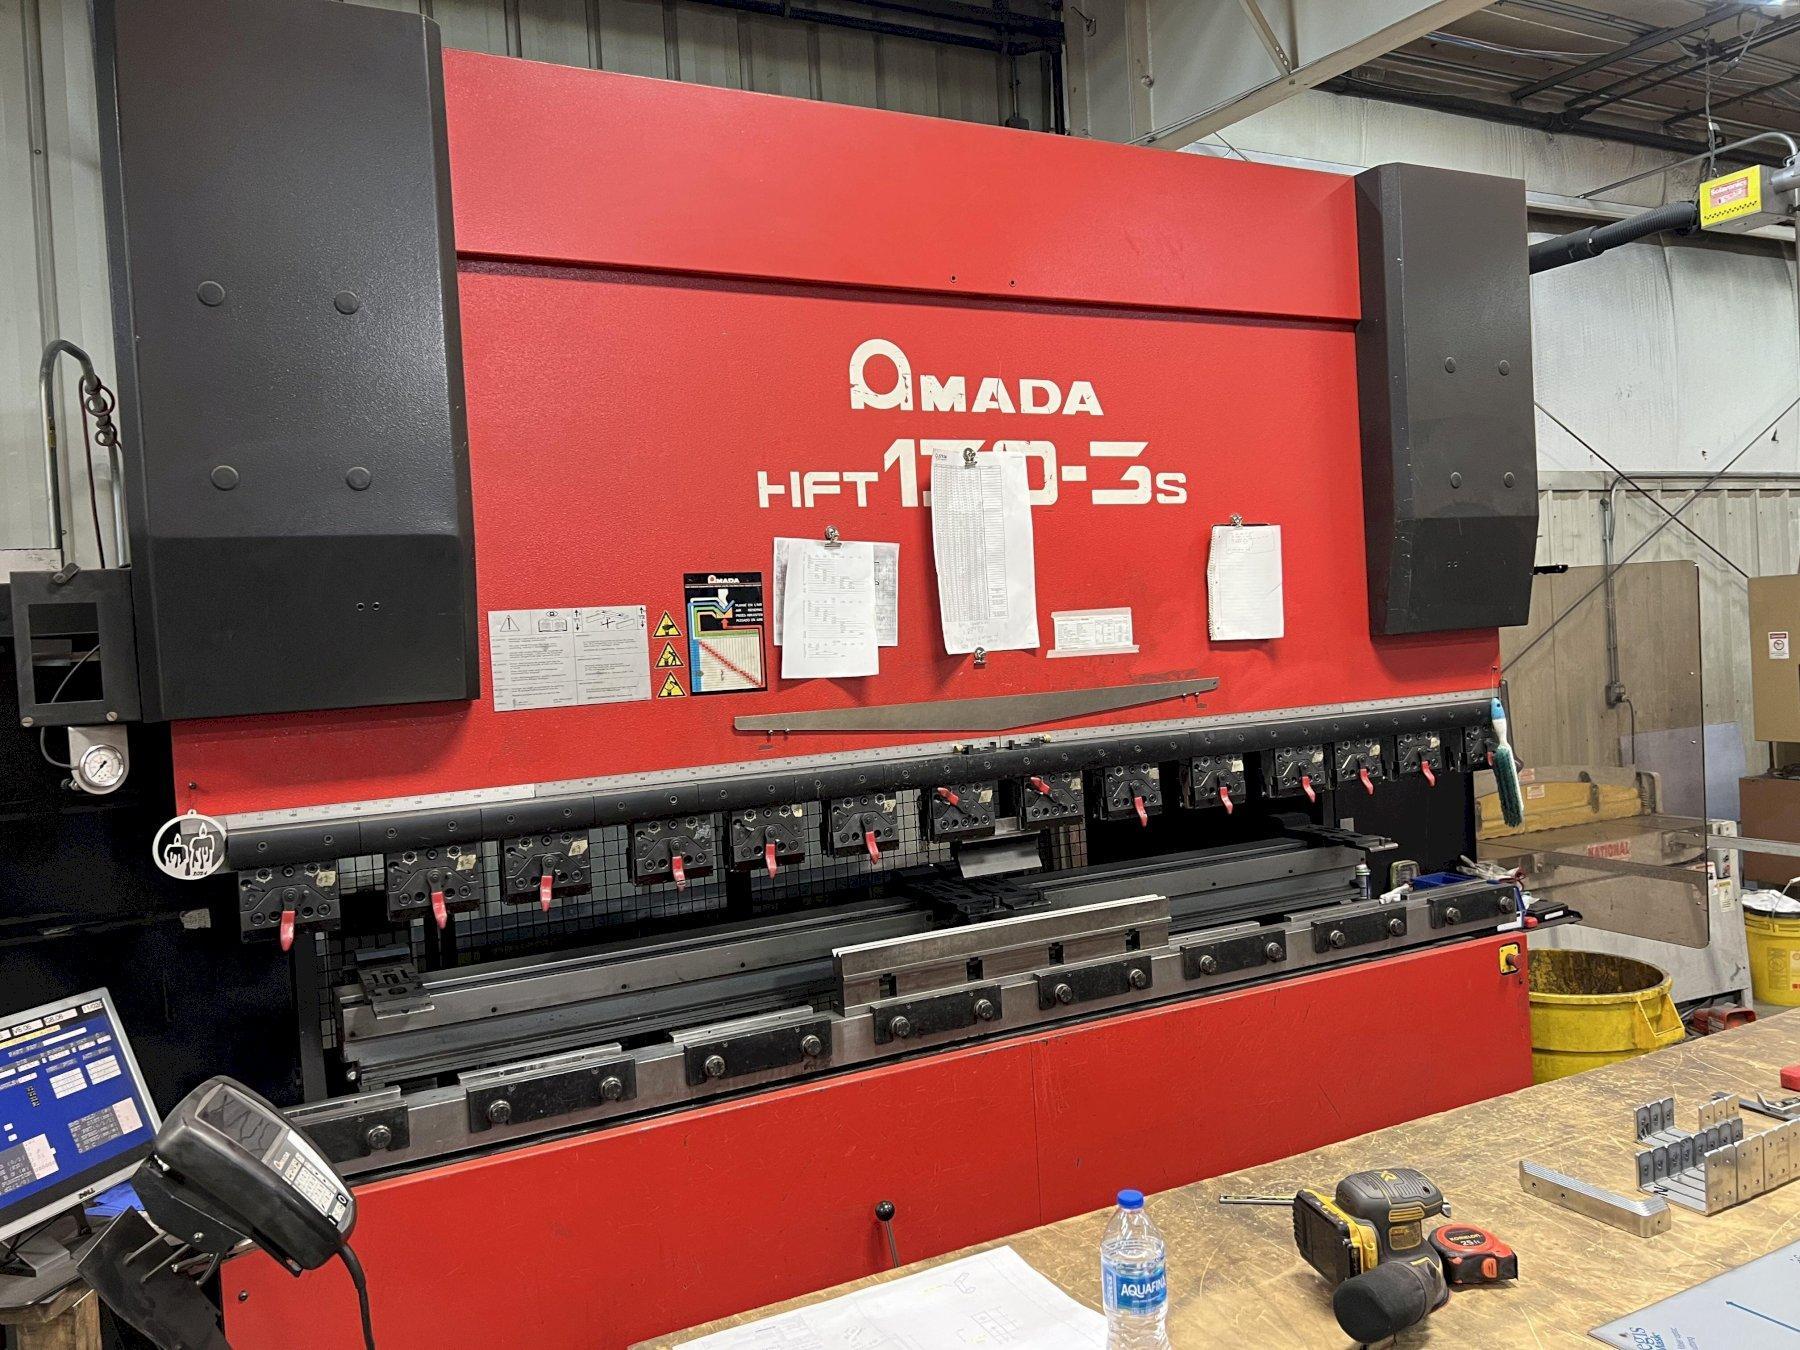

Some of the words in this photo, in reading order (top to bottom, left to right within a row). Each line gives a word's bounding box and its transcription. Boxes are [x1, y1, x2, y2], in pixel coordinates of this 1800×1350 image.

[849, 338, 1104, 416] AMADA
[707, 575, 740, 584] AMADA
[79, 1188, 95, 1199] DELL
